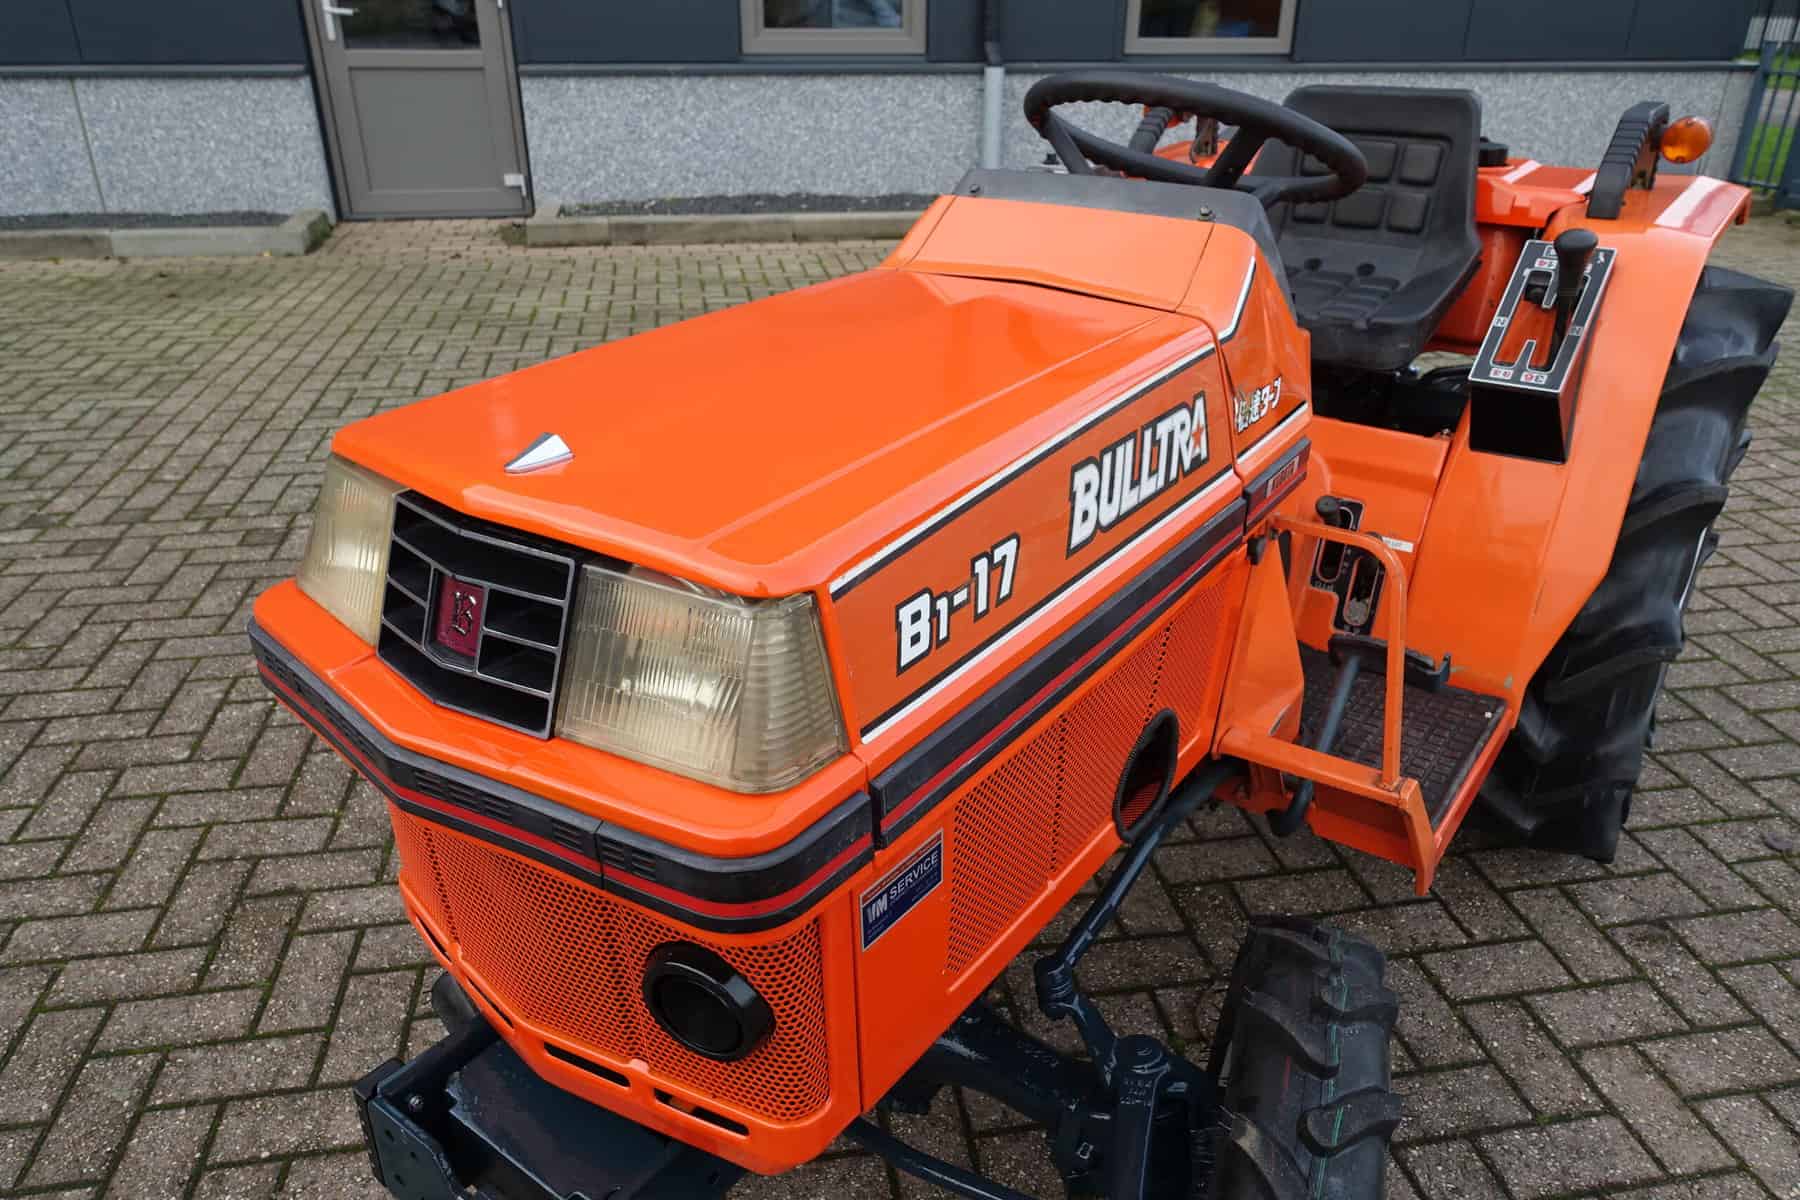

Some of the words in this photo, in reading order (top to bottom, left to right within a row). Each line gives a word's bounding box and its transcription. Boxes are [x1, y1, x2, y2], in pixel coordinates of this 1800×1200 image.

[1067, 391, 1209, 558] BULLTRA
[897, 533, 1020, 675] B1-17
[889, 850, 938, 901] SERVICE
